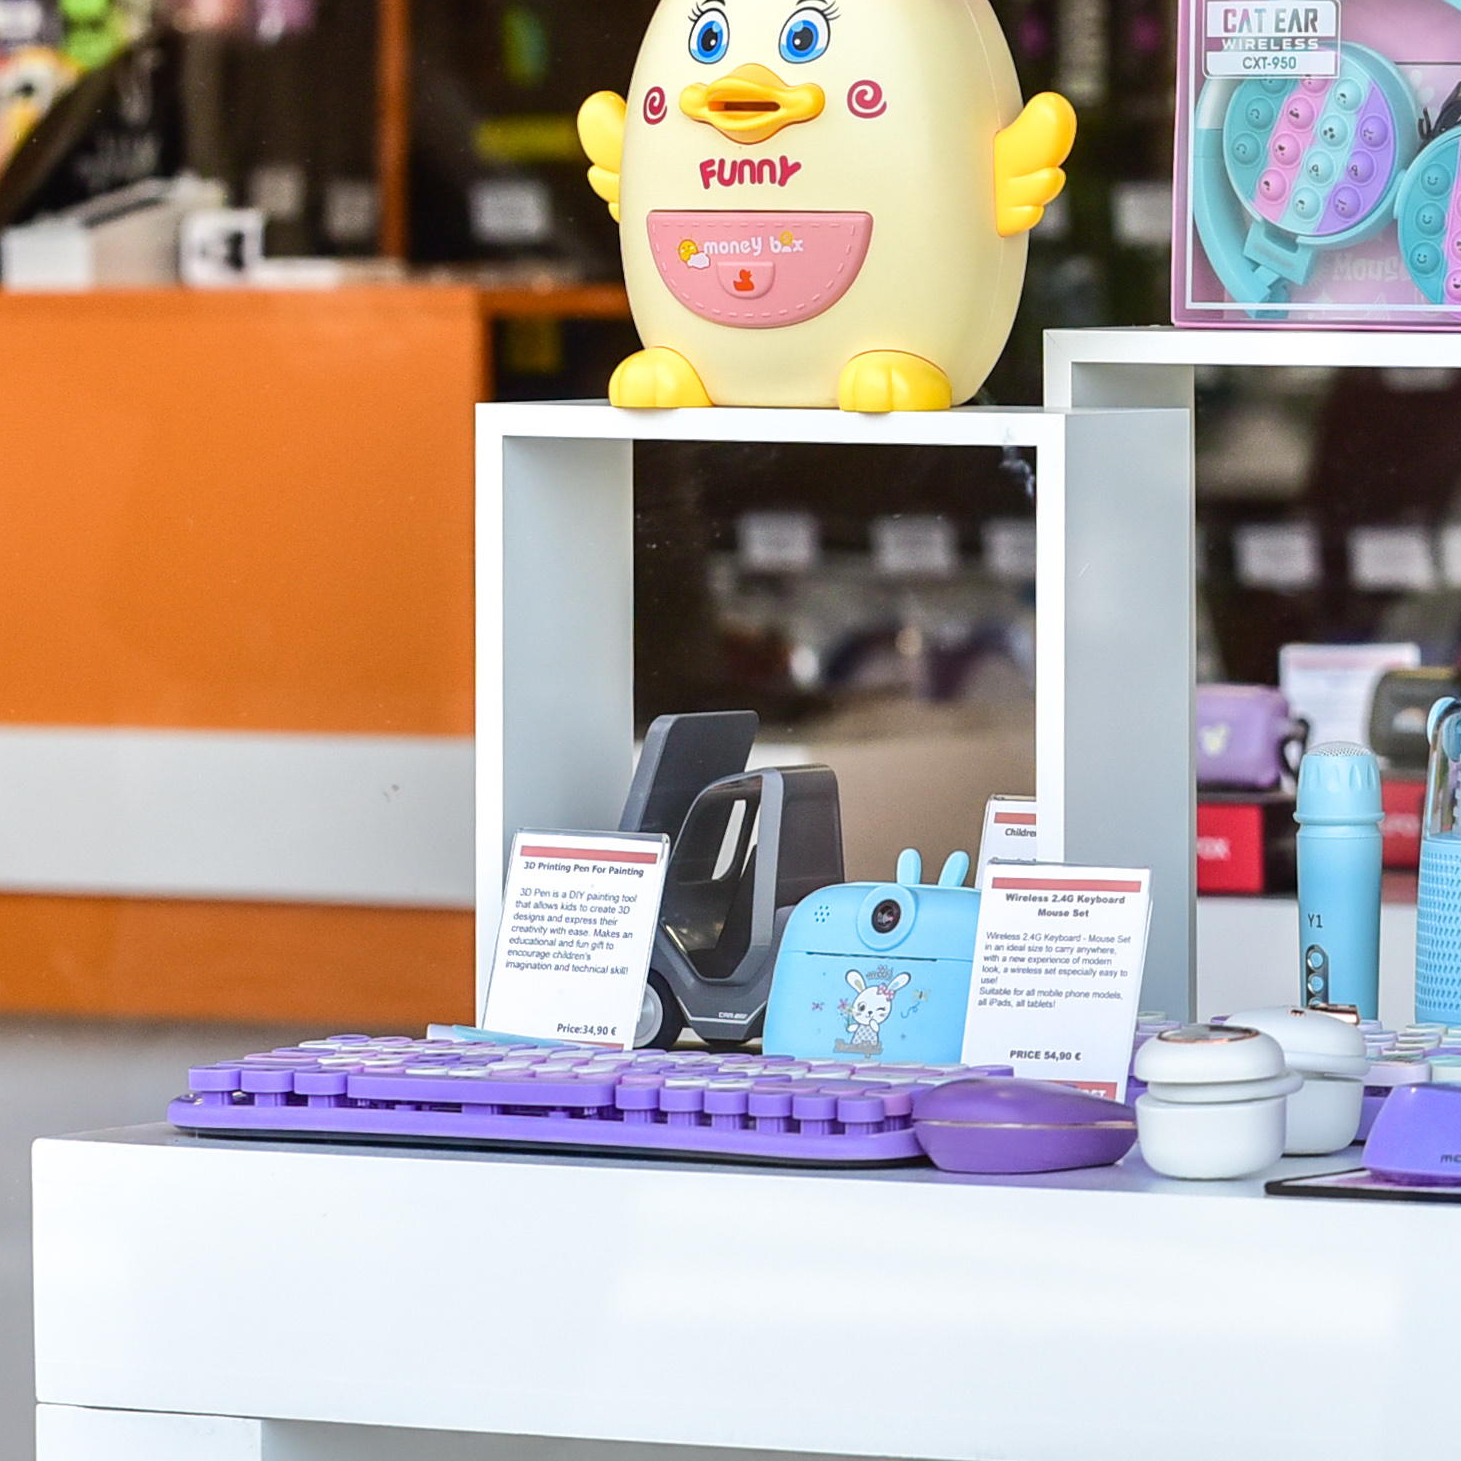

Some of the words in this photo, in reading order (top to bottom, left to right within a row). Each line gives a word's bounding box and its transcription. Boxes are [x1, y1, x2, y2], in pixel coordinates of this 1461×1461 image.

[1223, 9, 1265, 34] CAT
[1274, 7, 1319, 33] EAR
[1221, 37, 1320, 51] WIRELESS
[1241, 55, 1298, 71] CXT-950
[704, 235, 764, 257] money
[523, 861, 536, 869] 3D
[537, 861, 571, 873] Printing
[572, 863, 589, 872] Pen
[591, 864, 606, 873] For
[608, 865, 644, 878] Painting
[519, 887, 532, 896] 3D
[533, 887, 550, 897] Pen
[568, 889, 585, 899] DIY
[585, 893, 620, 904] painting
[621, 894, 637, 902] tool
[1005, 892, 1048, 902] Wireless
[1051, 893, 1074, 902] 2.4G
[1076, 894, 1125, 905] Keyboard
[1037, 908, 1069, 917] Mouse
[1072, 908, 1089, 917] Set
[1307, 913, 1323, 928] Y1
[510, 925, 548, 935] creativity
[549, 926, 566, 934] with
[592, 928, 620, 938] Makes
[505, 959, 552, 971] imagination
[553, 962, 570, 971] and
[571, 963, 608, 973] technical
[609, 965, 628, 974] skill!
[977, 997, 987, 1006] all
[988, 998, 1013, 1007] iPads,
[1015, 999, 1025, 1007] all
[1026, 999, 1055, 1008] tablets!
[556, 1023, 608, 1035] Price:34,90
[1009, 1049, 1041, 1059] PRICE
[1043, 1050, 1071, 1061] 54,90
